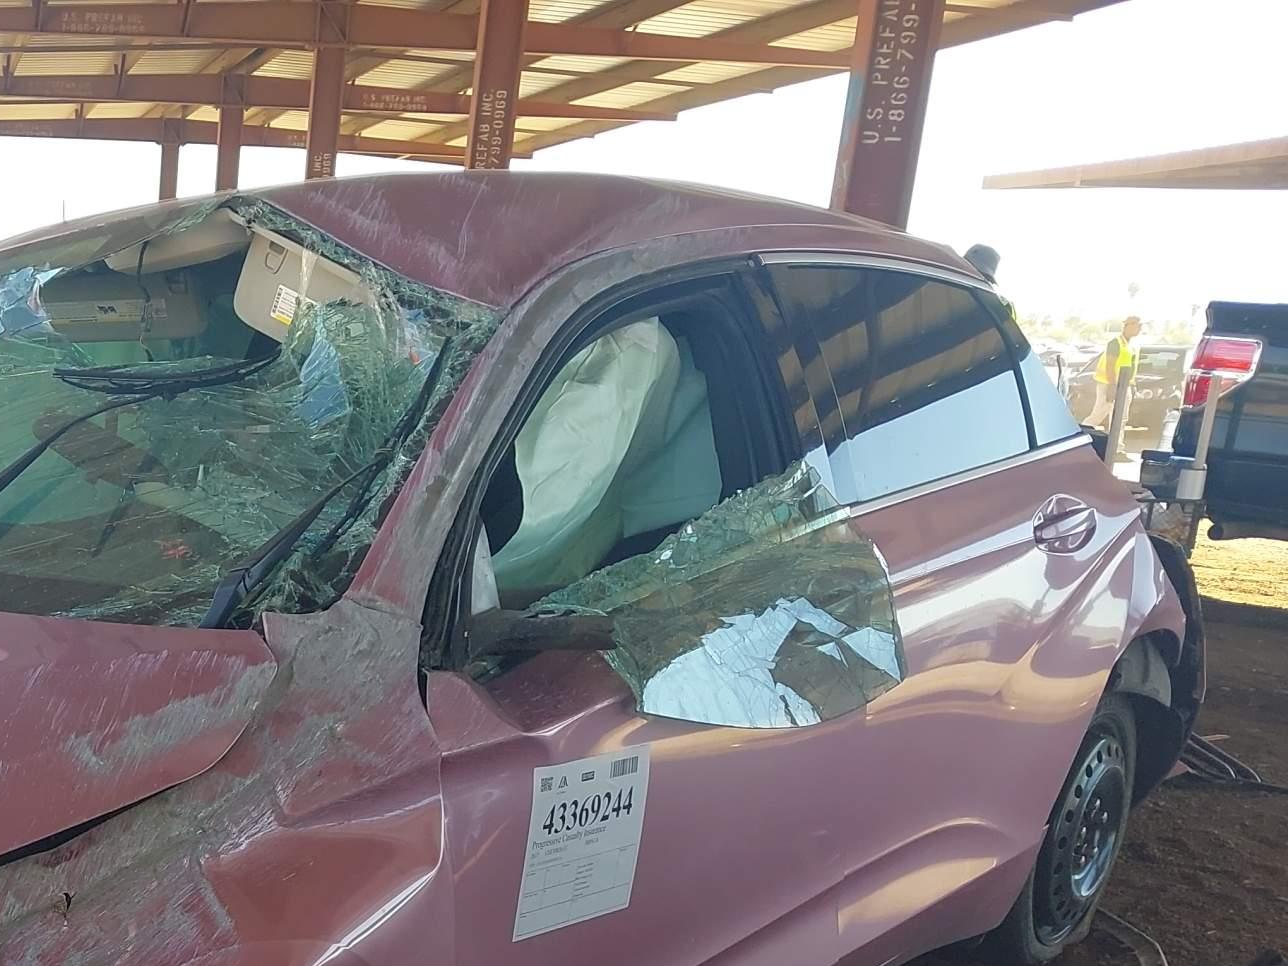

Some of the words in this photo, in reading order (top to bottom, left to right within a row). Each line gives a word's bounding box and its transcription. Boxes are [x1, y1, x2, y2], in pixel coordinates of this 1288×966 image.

[480, 88, 495, 116] INC.
[862, 100, 885, 144] U.S.
[542, 785, 633, 836] 43369244
